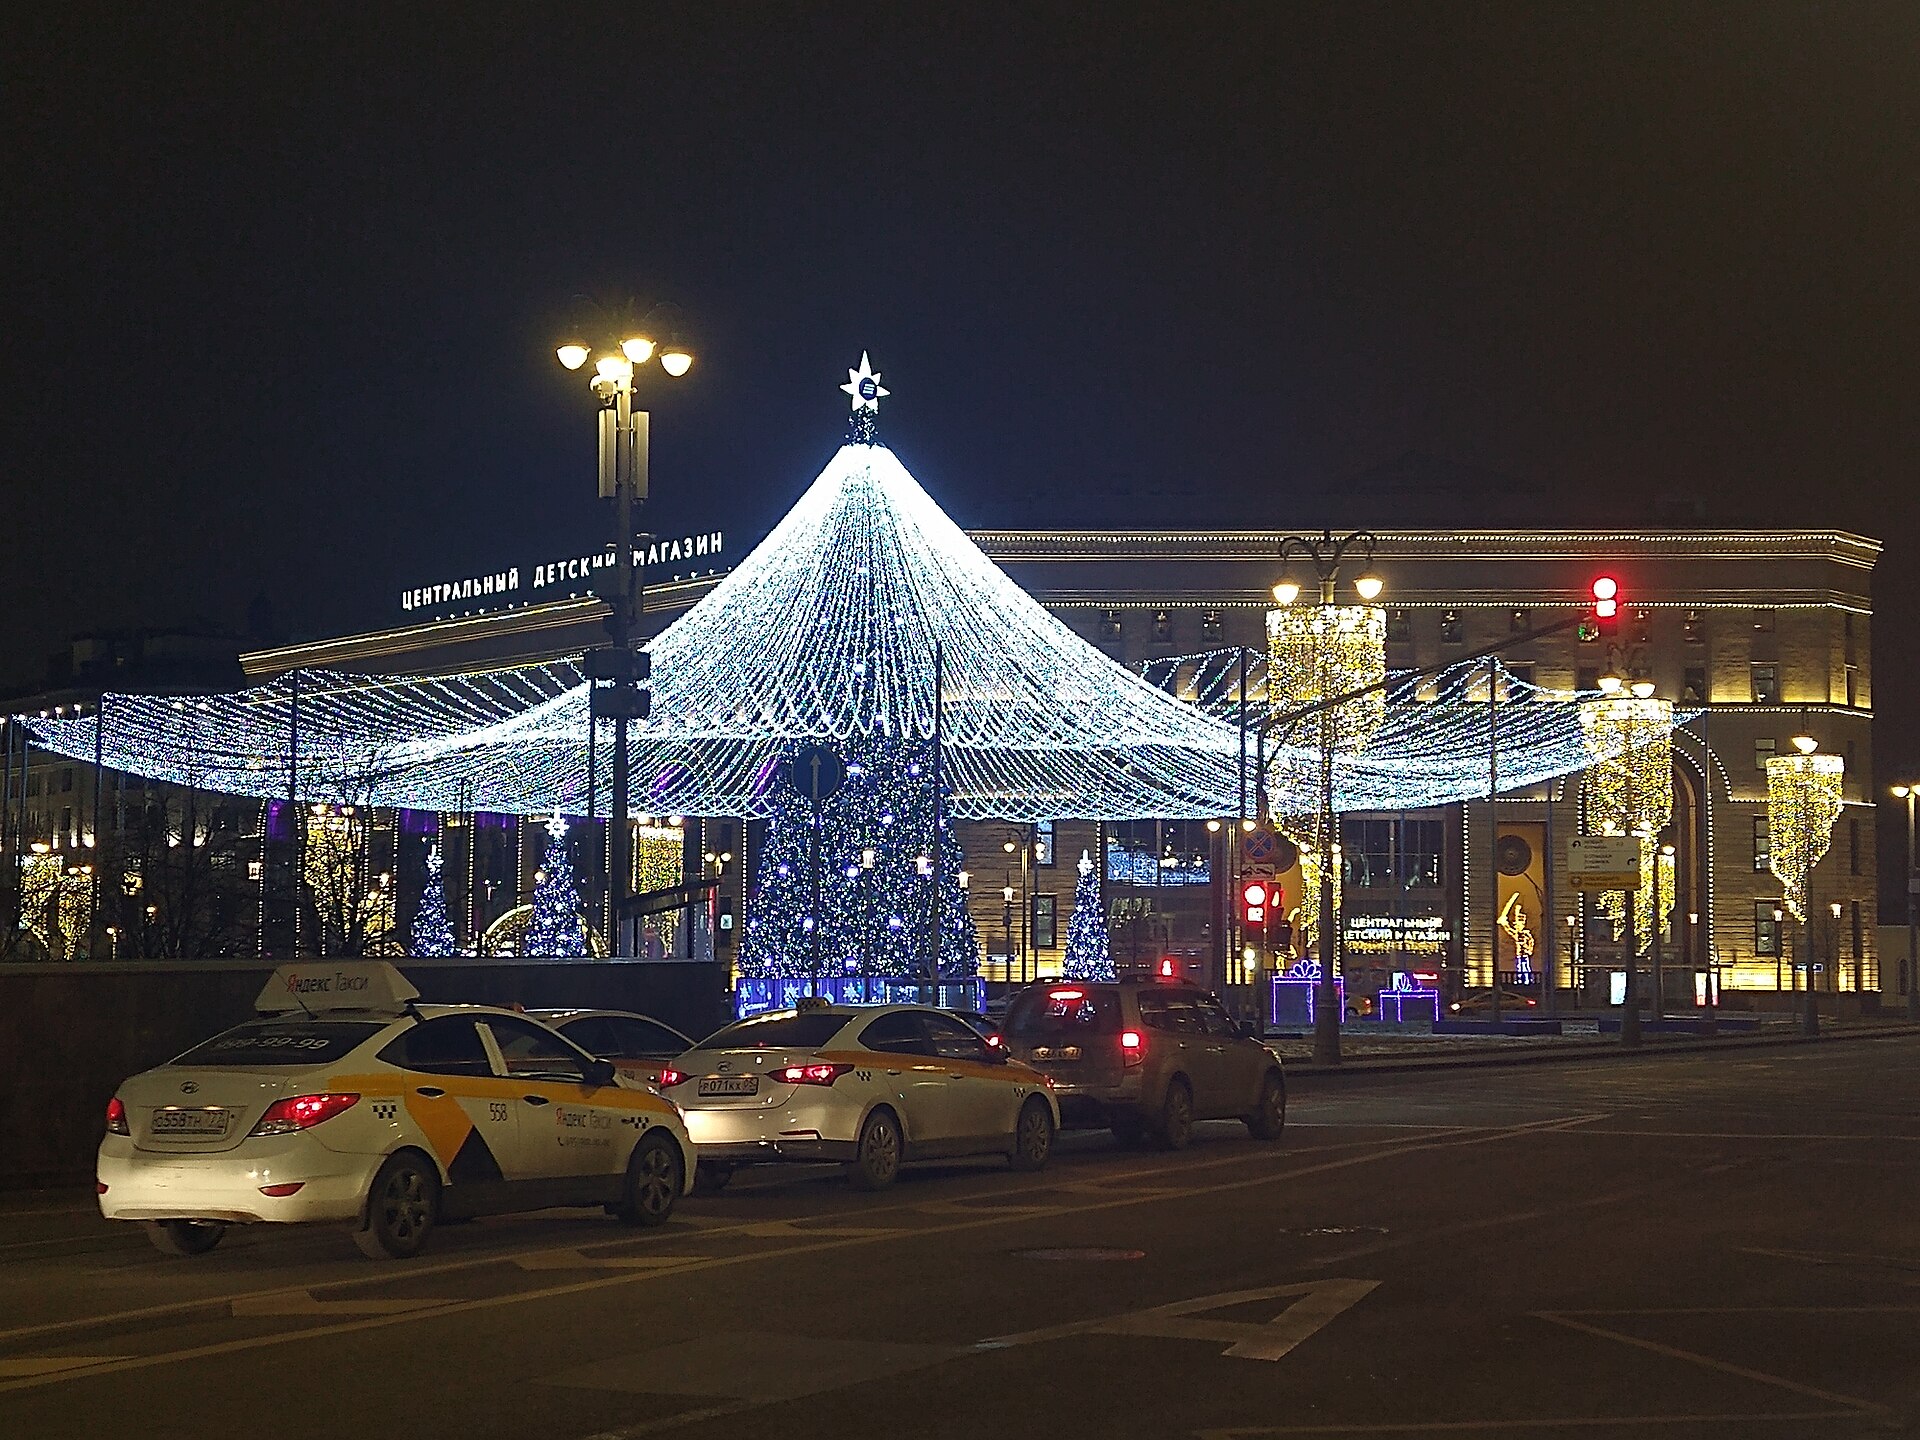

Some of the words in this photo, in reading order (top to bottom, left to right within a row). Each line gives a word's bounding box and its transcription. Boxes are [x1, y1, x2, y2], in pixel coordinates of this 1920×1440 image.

[402, 567, 519, 610] ЦЕНТРАЛЬНЫЙ
[631, 531, 723, 567] МАГАЗИН
[286, 974, 332, 993] Яндекс
[335, 972, 369, 991] Такси
[490, 1103, 507, 1121] 558
[556, 1107, 586, 1127] Яндекс
